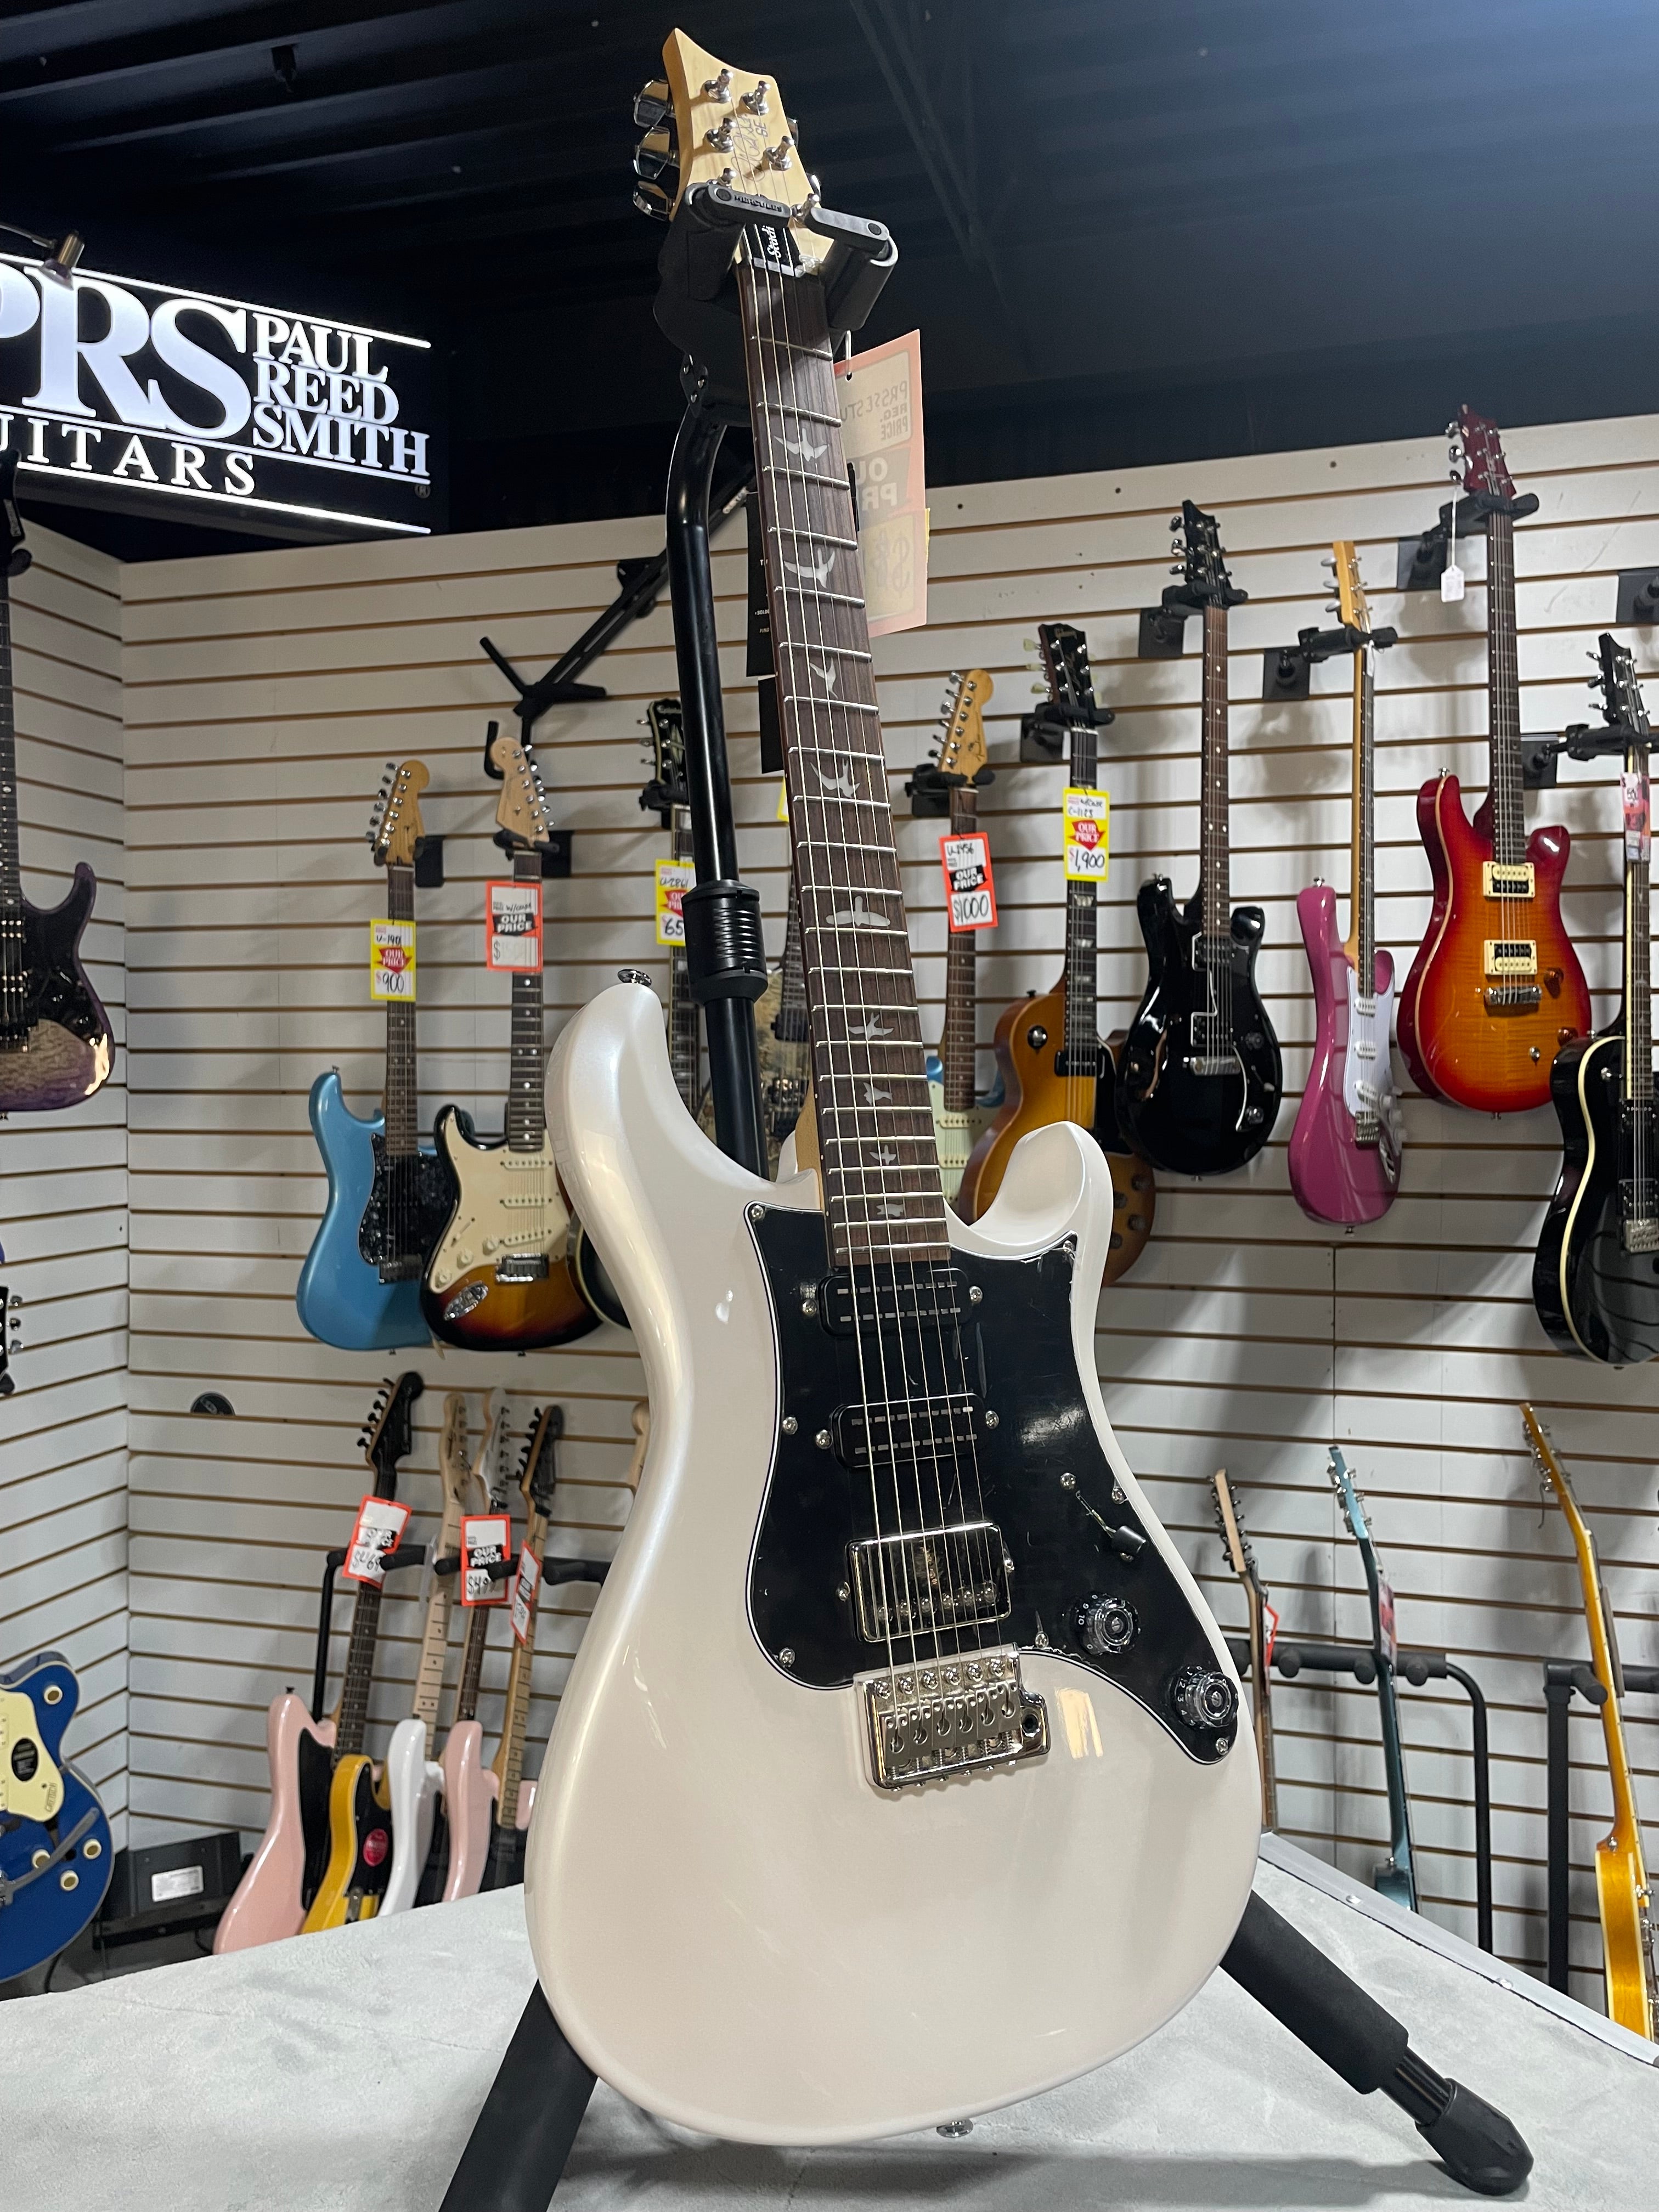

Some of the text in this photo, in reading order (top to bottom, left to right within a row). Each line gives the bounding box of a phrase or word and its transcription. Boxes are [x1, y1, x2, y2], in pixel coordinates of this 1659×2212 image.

[252, 312, 388, 383] PAUL
[253, 357, 400, 425] REED
[252, 404, 431, 477] SMITH
[1077, 822, 1097, 834] OUR
[1075, 831, 1100, 843] PRICE
[955, 867, 978, 881] OUR
[953, 873, 984, 891] PRICE
[953, 894, 989, 924] $1000
[501, 913, 527, 924] OUR
[497, 921, 533, 934] PRICE
[473, 1545, 497, 1558] OUR
[470, 1553, 502, 1567] PRICE
[1078, 1614, 1085, 1626] 10
